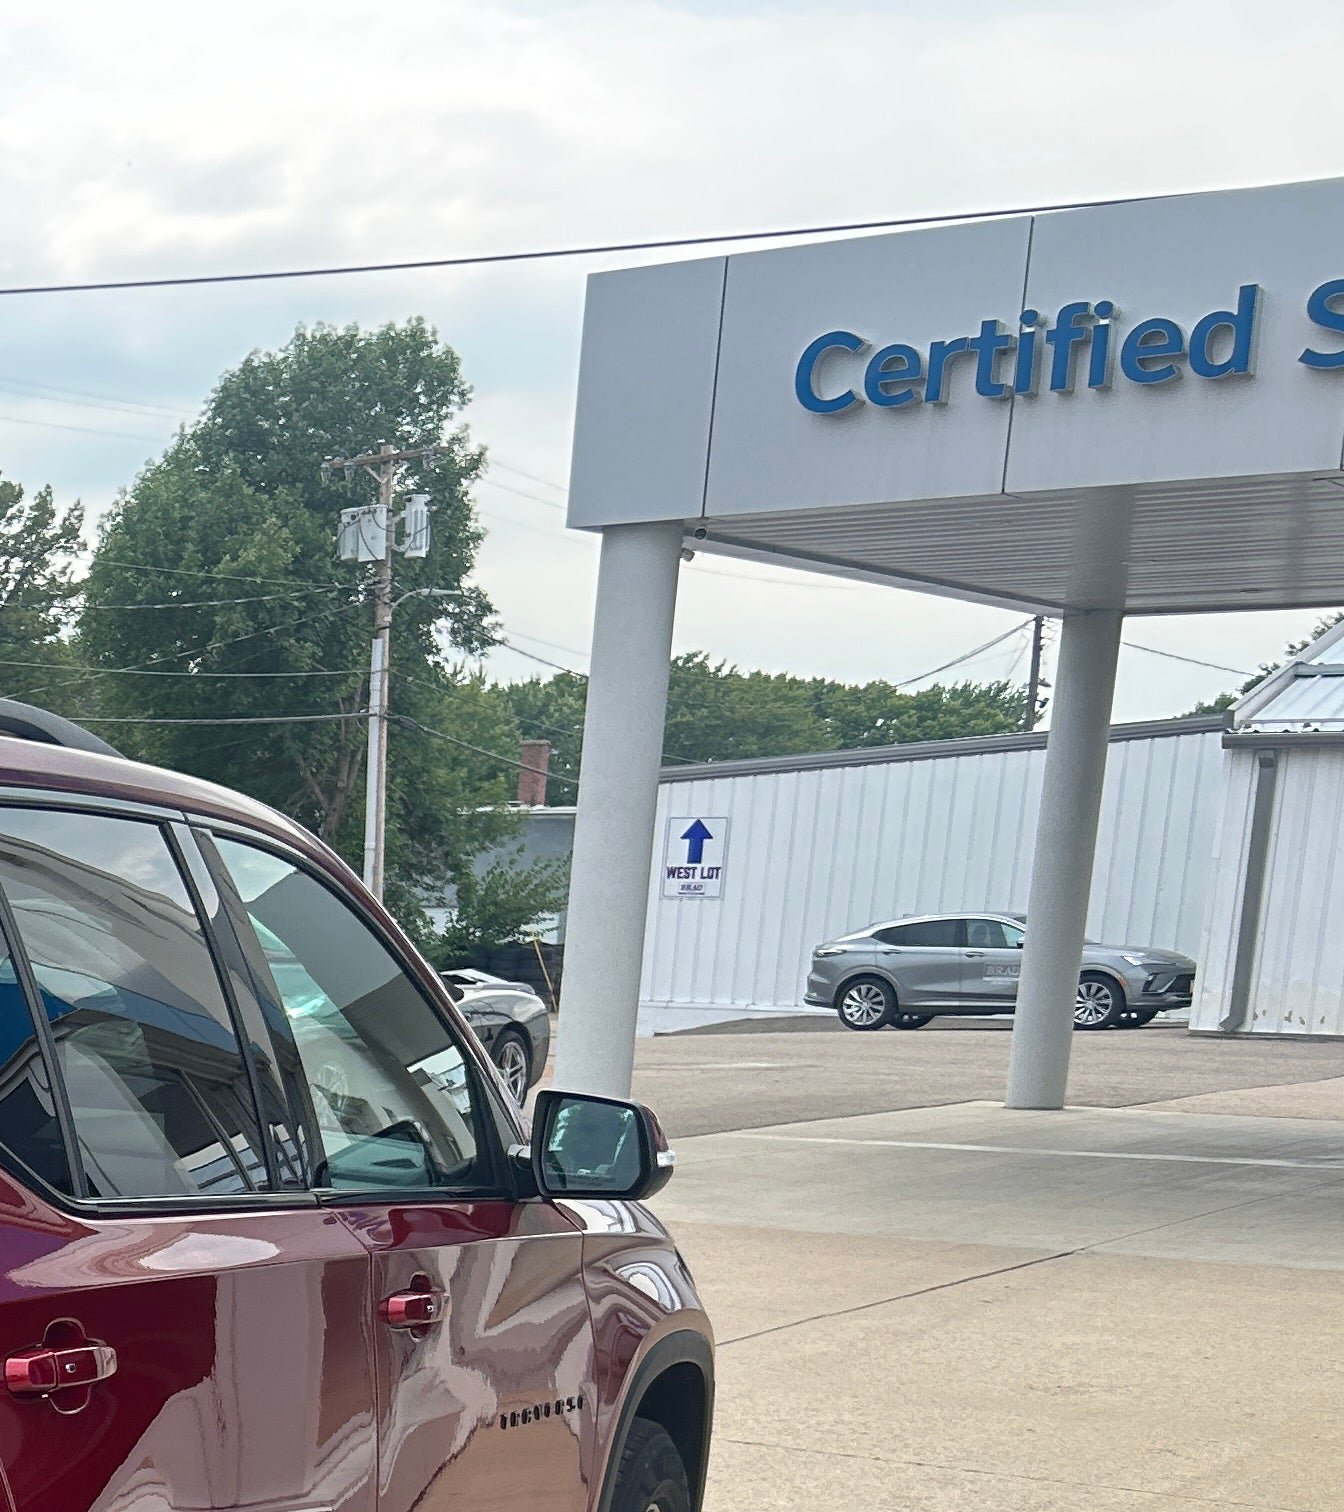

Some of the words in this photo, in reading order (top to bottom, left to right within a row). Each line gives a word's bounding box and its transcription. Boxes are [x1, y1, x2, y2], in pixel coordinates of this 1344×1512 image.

[795, 284, 1260, 414] Certified
[666, 866, 697, 879] WEST
[700, 866, 721, 879] LOT
